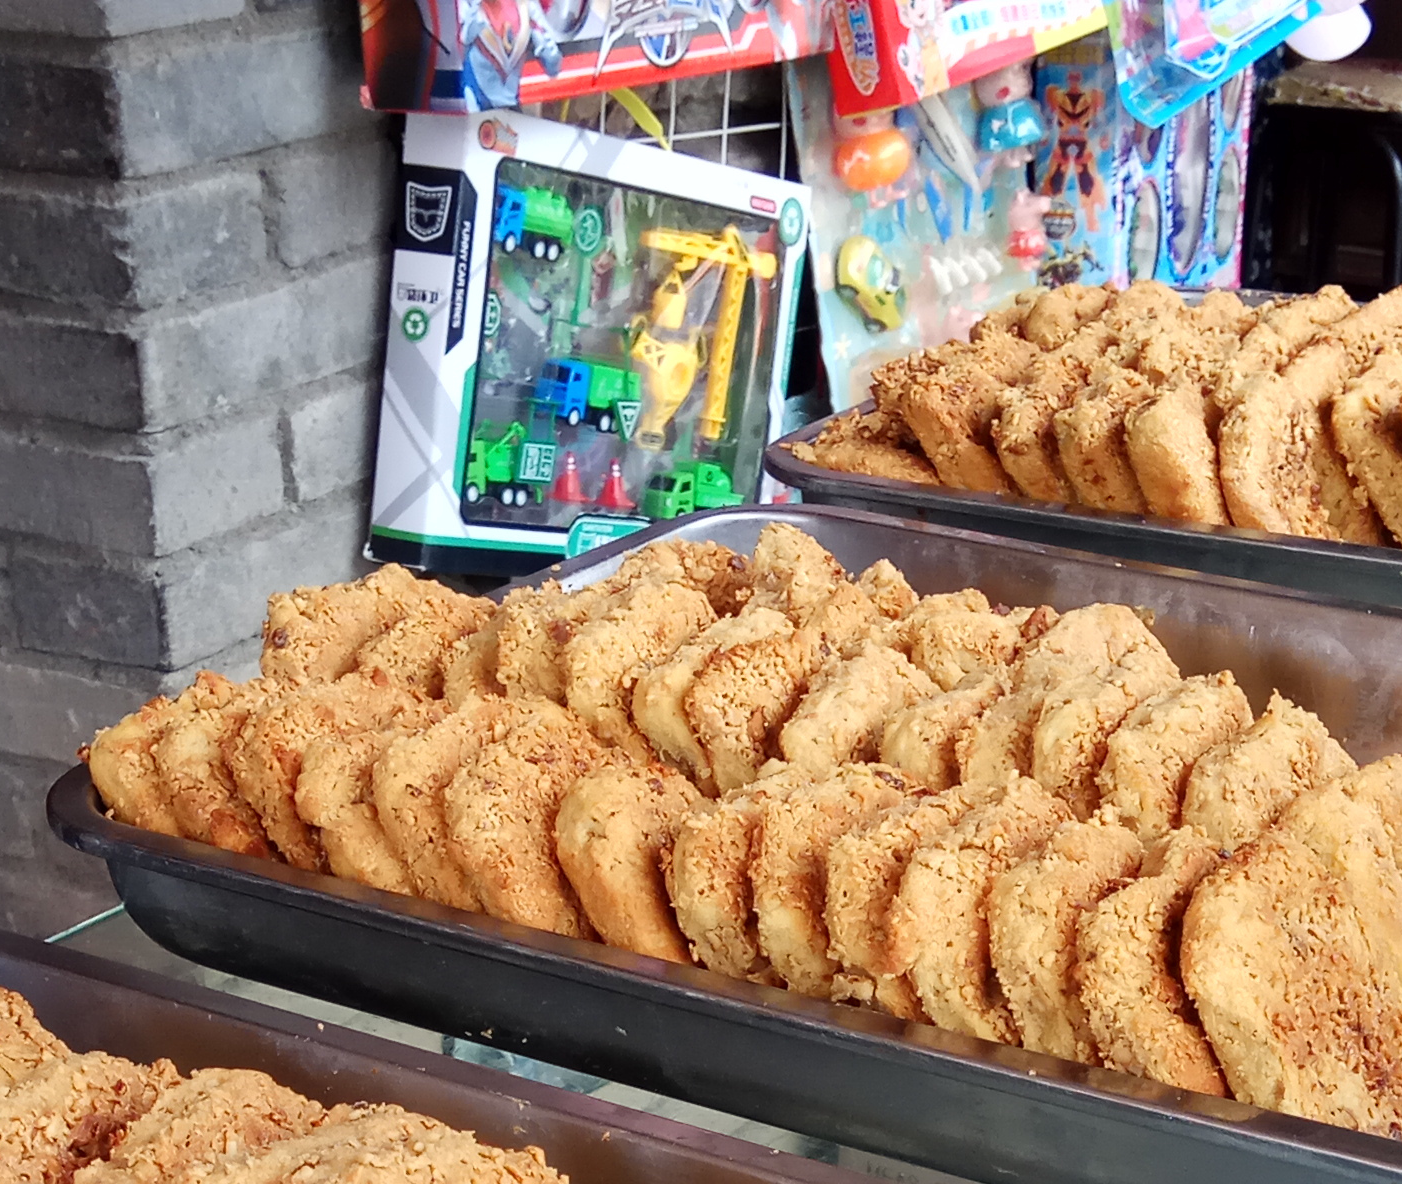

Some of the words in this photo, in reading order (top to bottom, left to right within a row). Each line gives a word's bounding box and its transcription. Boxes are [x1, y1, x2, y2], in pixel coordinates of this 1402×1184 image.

[460, 220, 472, 261] FUNNY
[457, 262, 468, 288] CAR
[451, 288, 465, 329] SERIES
